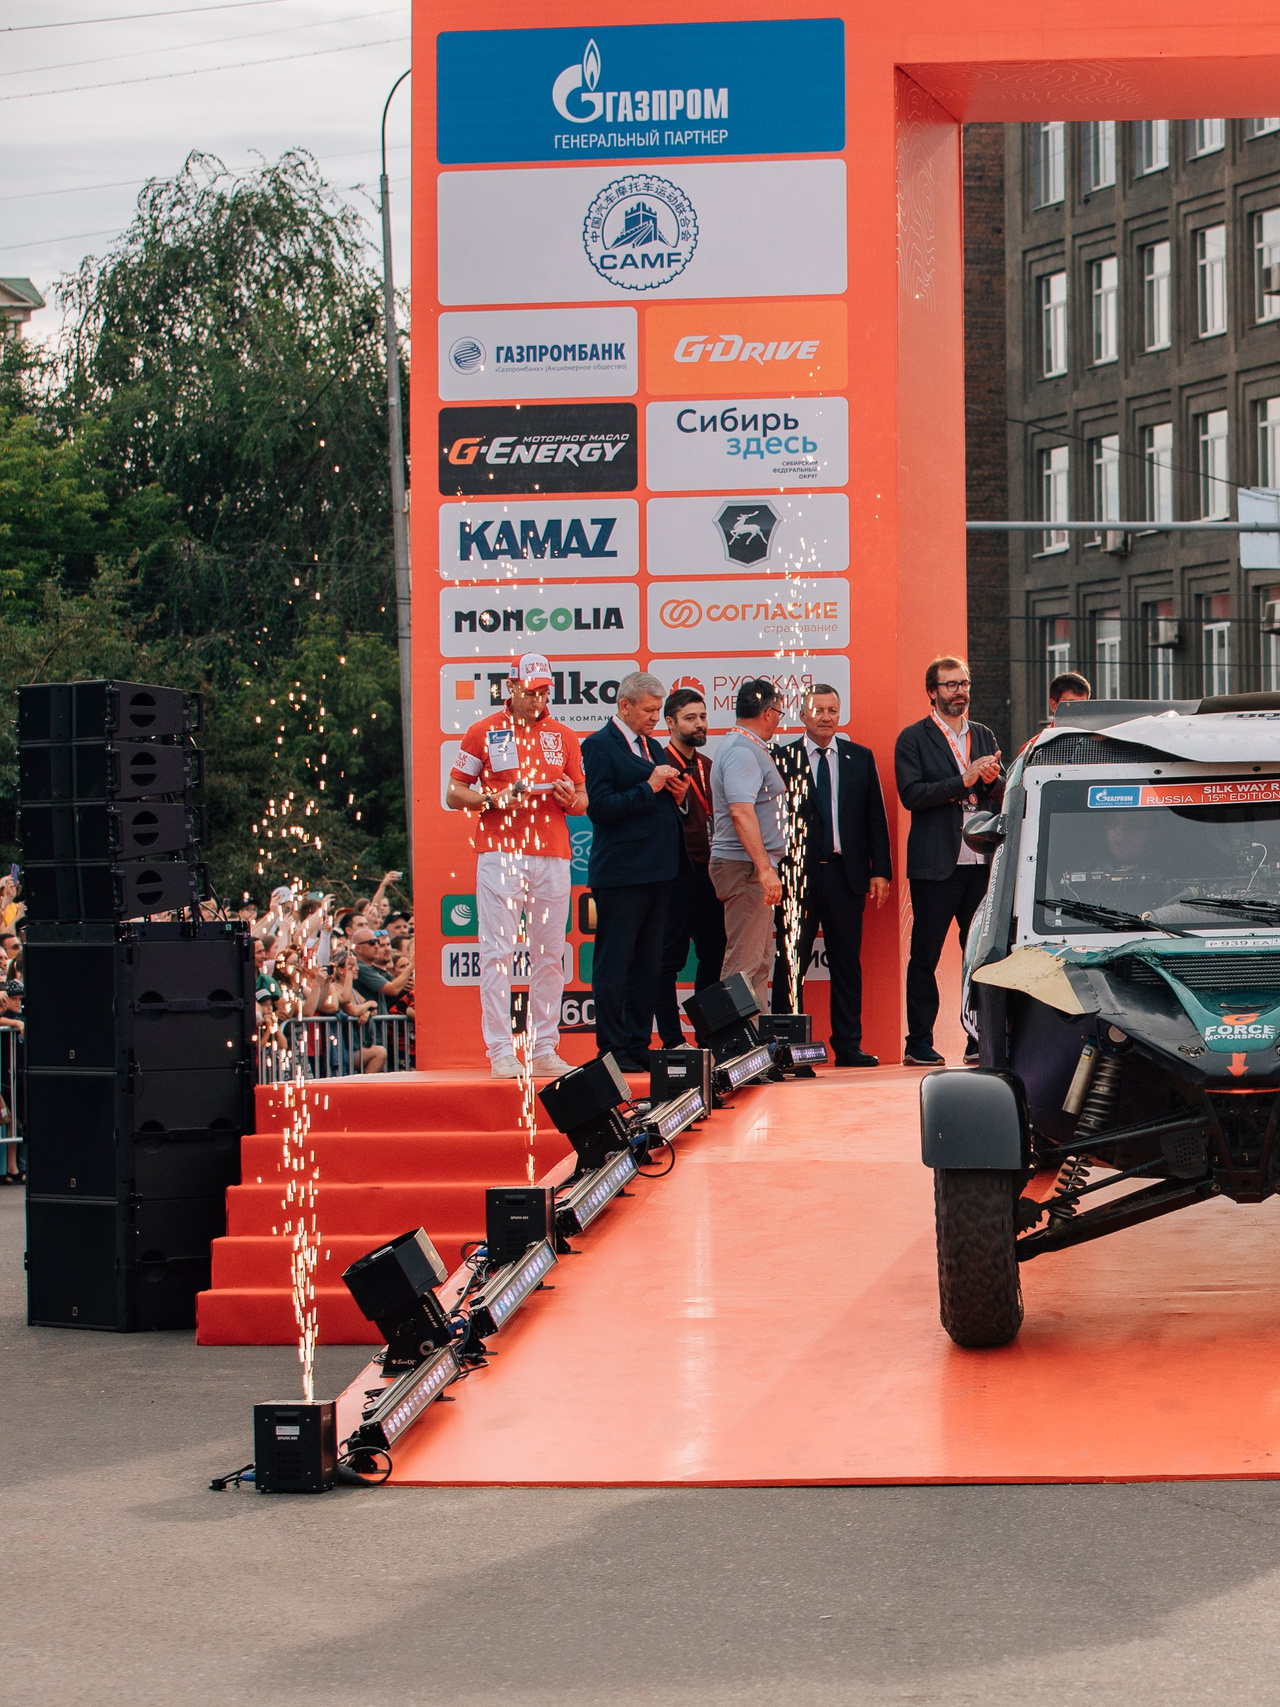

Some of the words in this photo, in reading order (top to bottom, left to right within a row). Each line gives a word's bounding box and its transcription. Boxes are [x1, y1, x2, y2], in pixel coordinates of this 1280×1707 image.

[605, 87, 729, 123] ГАЗПРОМ
[554, 130, 659, 149] ГЕНЕРАЛЬНЫЙ
[664, 129, 729, 147] ПАРТНЕР
[599, 252, 682, 270] CAMF
[495, 342, 626, 364] ГАЗПРОМБАНК
[676, 407, 800, 438] Сибирь
[522, 434, 587, 442] МОТОРНОЕ
[588, 433, 629, 441] МАСЛО
[726, 434, 818, 459] здесь
[459, 517, 618, 562] KAMAZ
[454, 607, 624, 634] MONGOLIA
[706, 601, 838, 622] СОГЛАСИЕ
[570, 714, 612, 722] КОМПАН
[543, 751, 564, 760] SILK
[545, 759, 564, 767] WAY
[1203, 784, 1233, 794] SILK
[1236, 782, 1267, 792] WAY
[1146, 795, 1194, 804] RUSSIA
[1208, 793, 1227, 802] 15th
[450, 951, 532, 978] ИЗВИЯ
[561, 999, 596, 1025] 60
[1204, 1033, 1275, 1041] MOTORSPORT
[1205, 1024, 1276, 1036] FORCE
